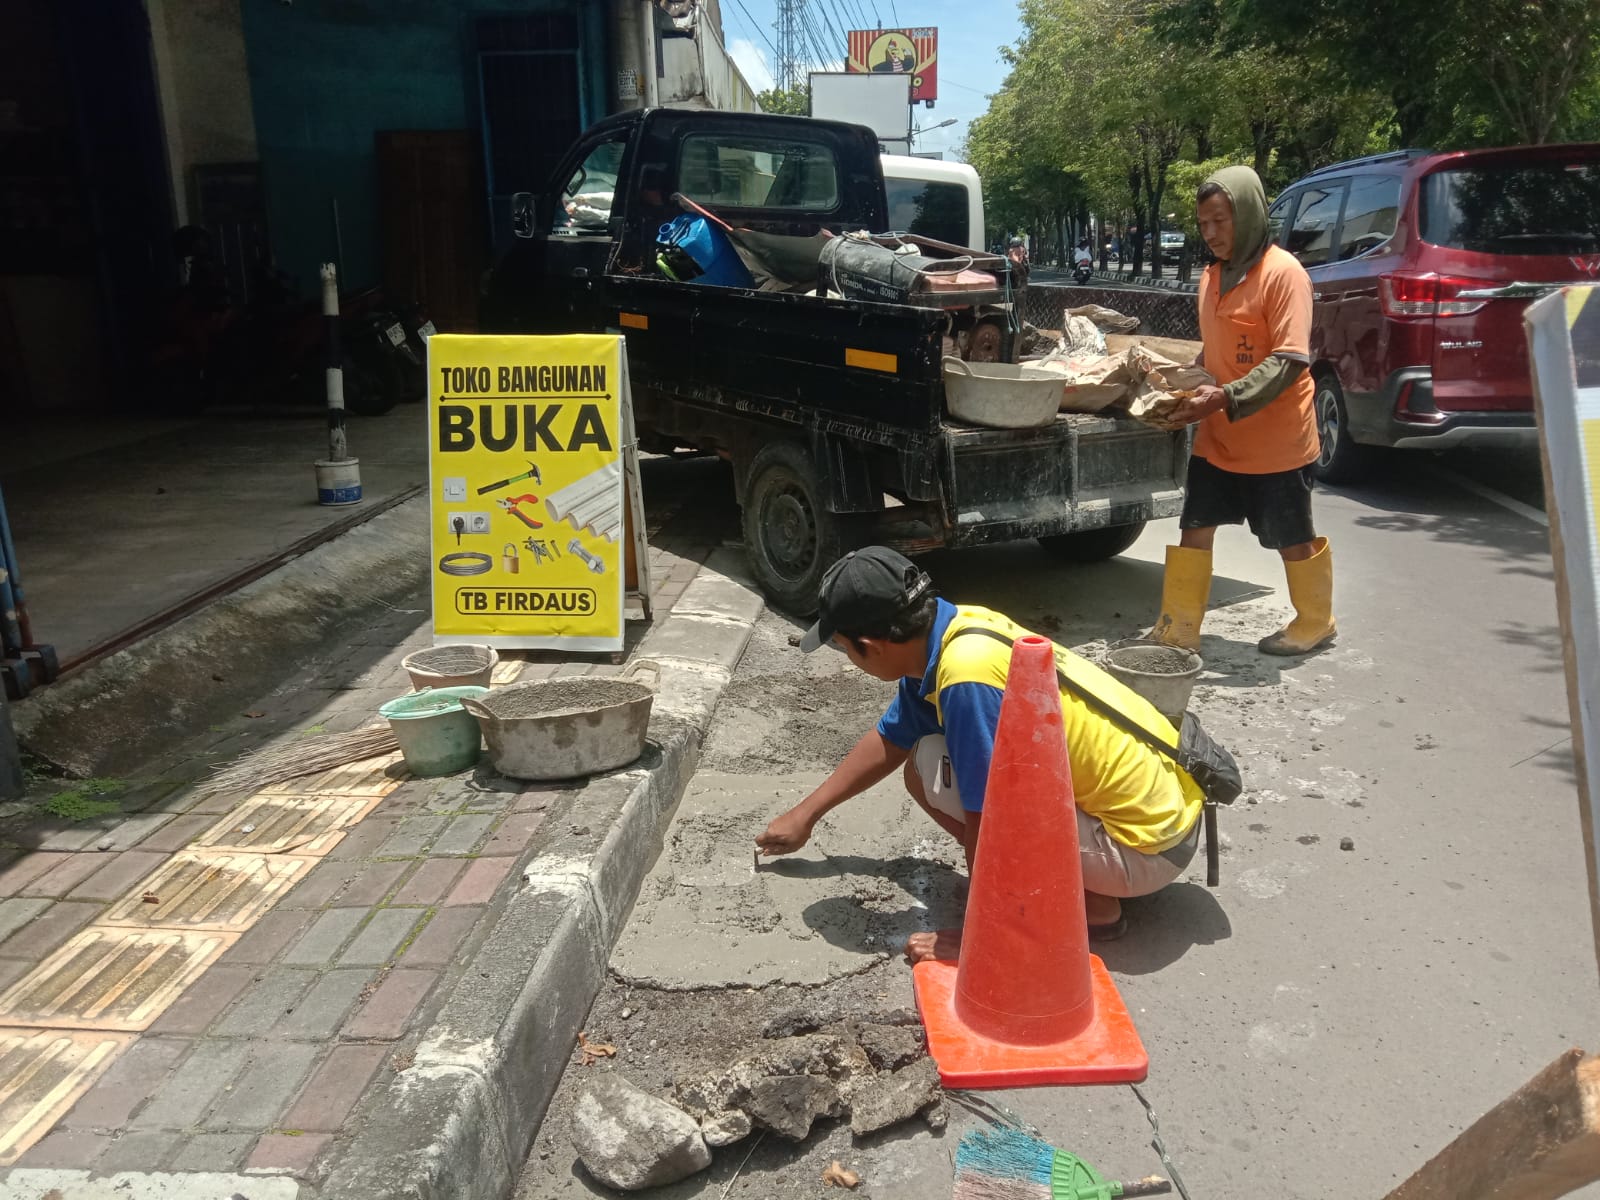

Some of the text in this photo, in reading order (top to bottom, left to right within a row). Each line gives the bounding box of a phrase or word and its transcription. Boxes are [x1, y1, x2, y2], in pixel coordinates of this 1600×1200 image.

[441, 365, 606, 393] TOKO BANGUNAN
[439, 404, 613, 452] BUKA
[461, 592, 591, 611] TB FIRDAUS
